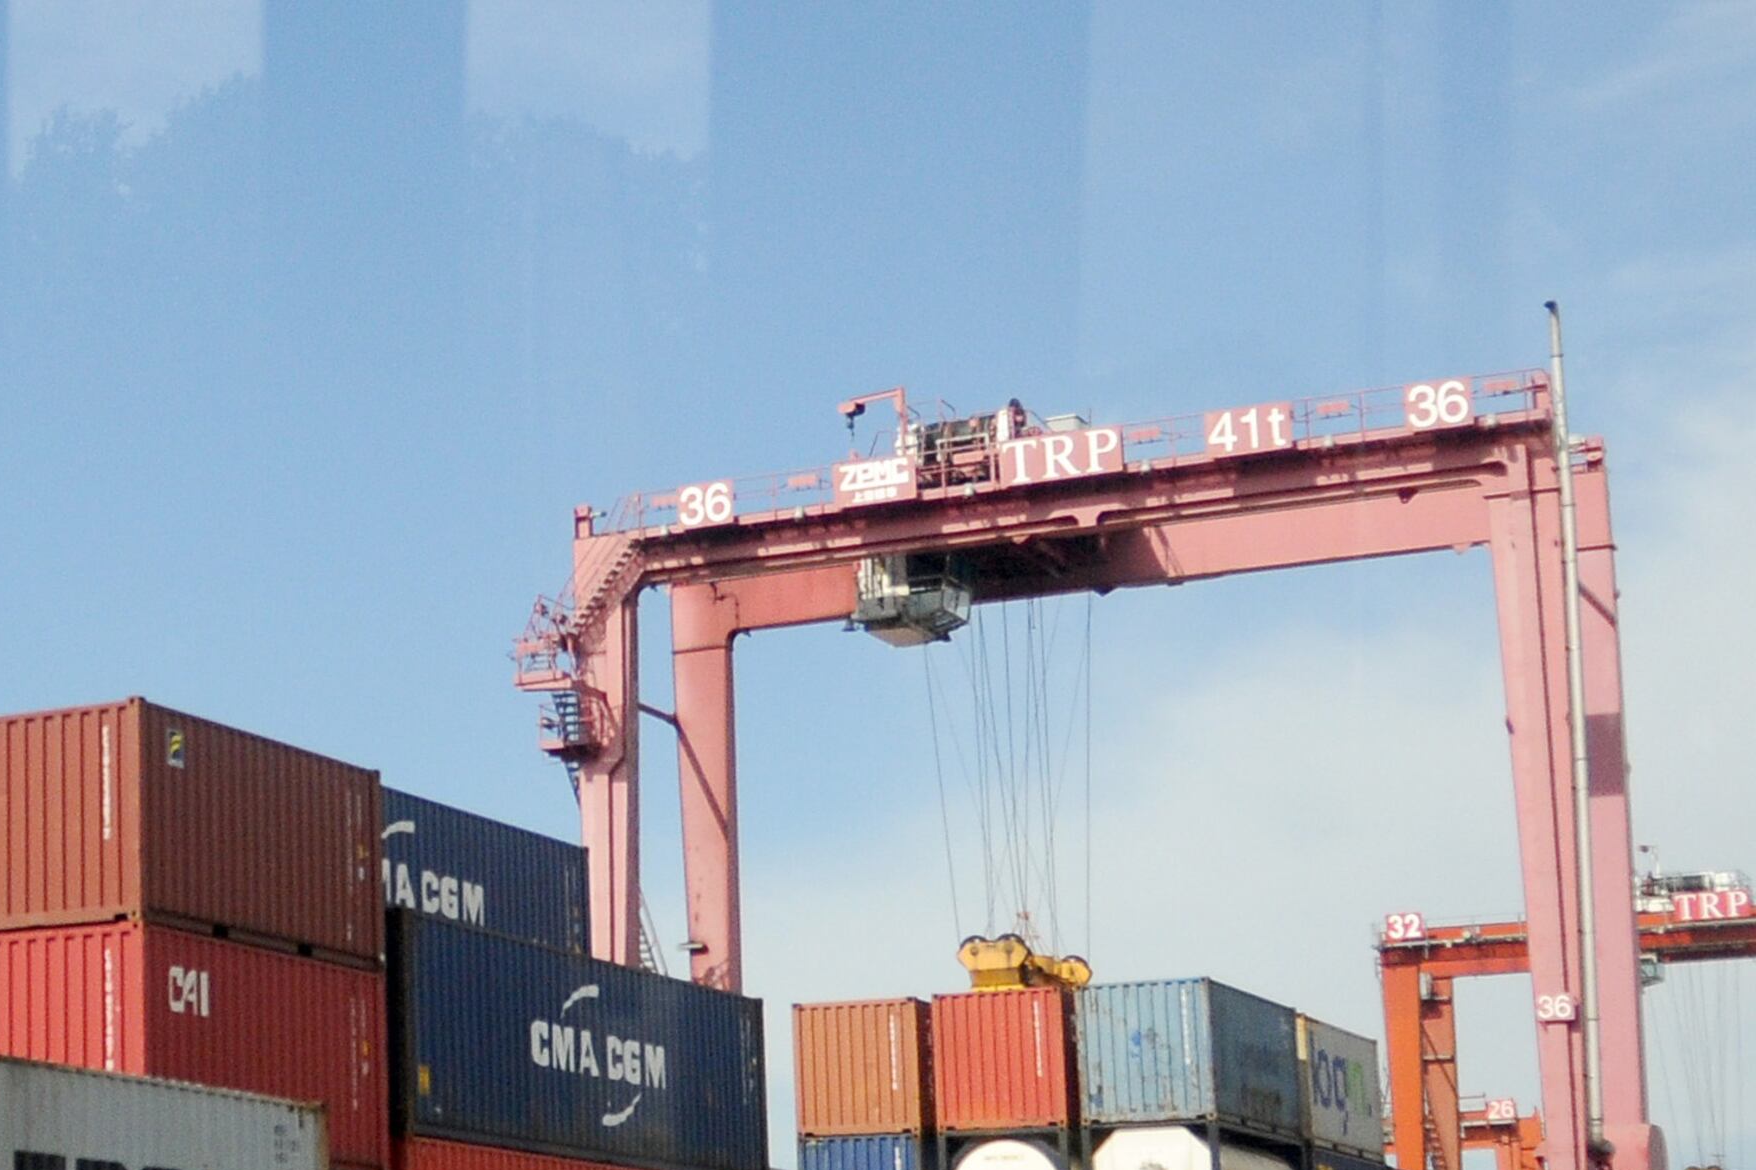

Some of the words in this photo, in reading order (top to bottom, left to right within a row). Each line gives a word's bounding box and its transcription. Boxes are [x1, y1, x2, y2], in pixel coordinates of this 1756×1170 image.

[1408, 380, 1470, 429] 36
[1207, 406, 1287, 452] 41t
[838, 457, 910, 492] ZPMC
[1001, 427, 1119, 485] TRP
[678, 482, 733, 525] 36
[421, 869, 485, 928] CGM
[1674, 890, 1751, 920] TRP
[1386, 913, 1422, 940] 32
[168, 965, 210, 1018] CAI
[1536, 994, 1572, 1020] 36
[530, 1019, 601, 1078] CMA
[605, 1034, 667, 1090] CGM
[1487, 1100, 1515, 1119] 26
